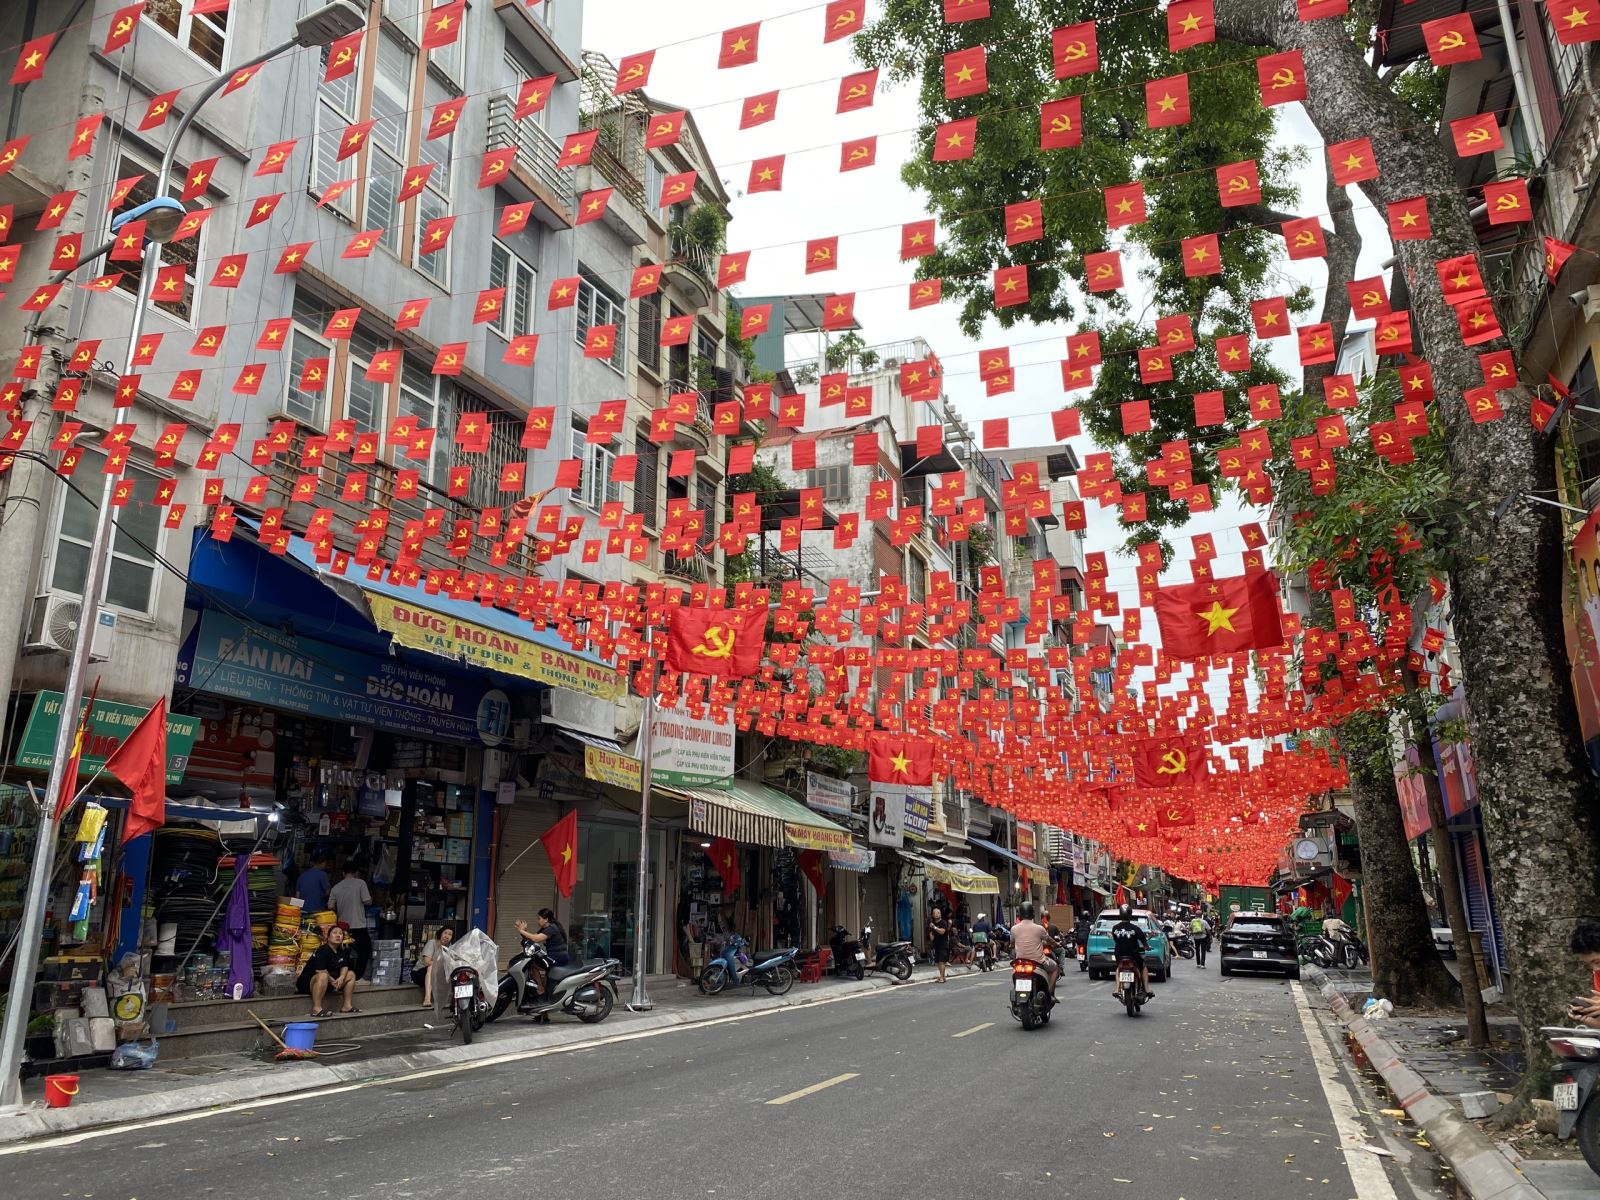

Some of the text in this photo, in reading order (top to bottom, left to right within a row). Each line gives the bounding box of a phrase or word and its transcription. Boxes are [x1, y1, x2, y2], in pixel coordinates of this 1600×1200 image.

[392, 605, 447, 634] ĐỨC
[454, 623, 519, 654] HOÀN
[424, 633, 452, 649] VẬT
[480, 647, 514, 667] ĐIỆN
[522, 661, 531, 670] &
[280, 681, 314, 700] THÔNG
[365, 674, 454, 712] ĐỨC HOÀN
[659, 721, 732, 748] TRADING COMPANY LIMITED
[174, 758, 182, 769] 5
[589, 752, 594, 765] 9
[599, 751, 616, 769] Huy
[619, 757, 640, 774] Hạnh
